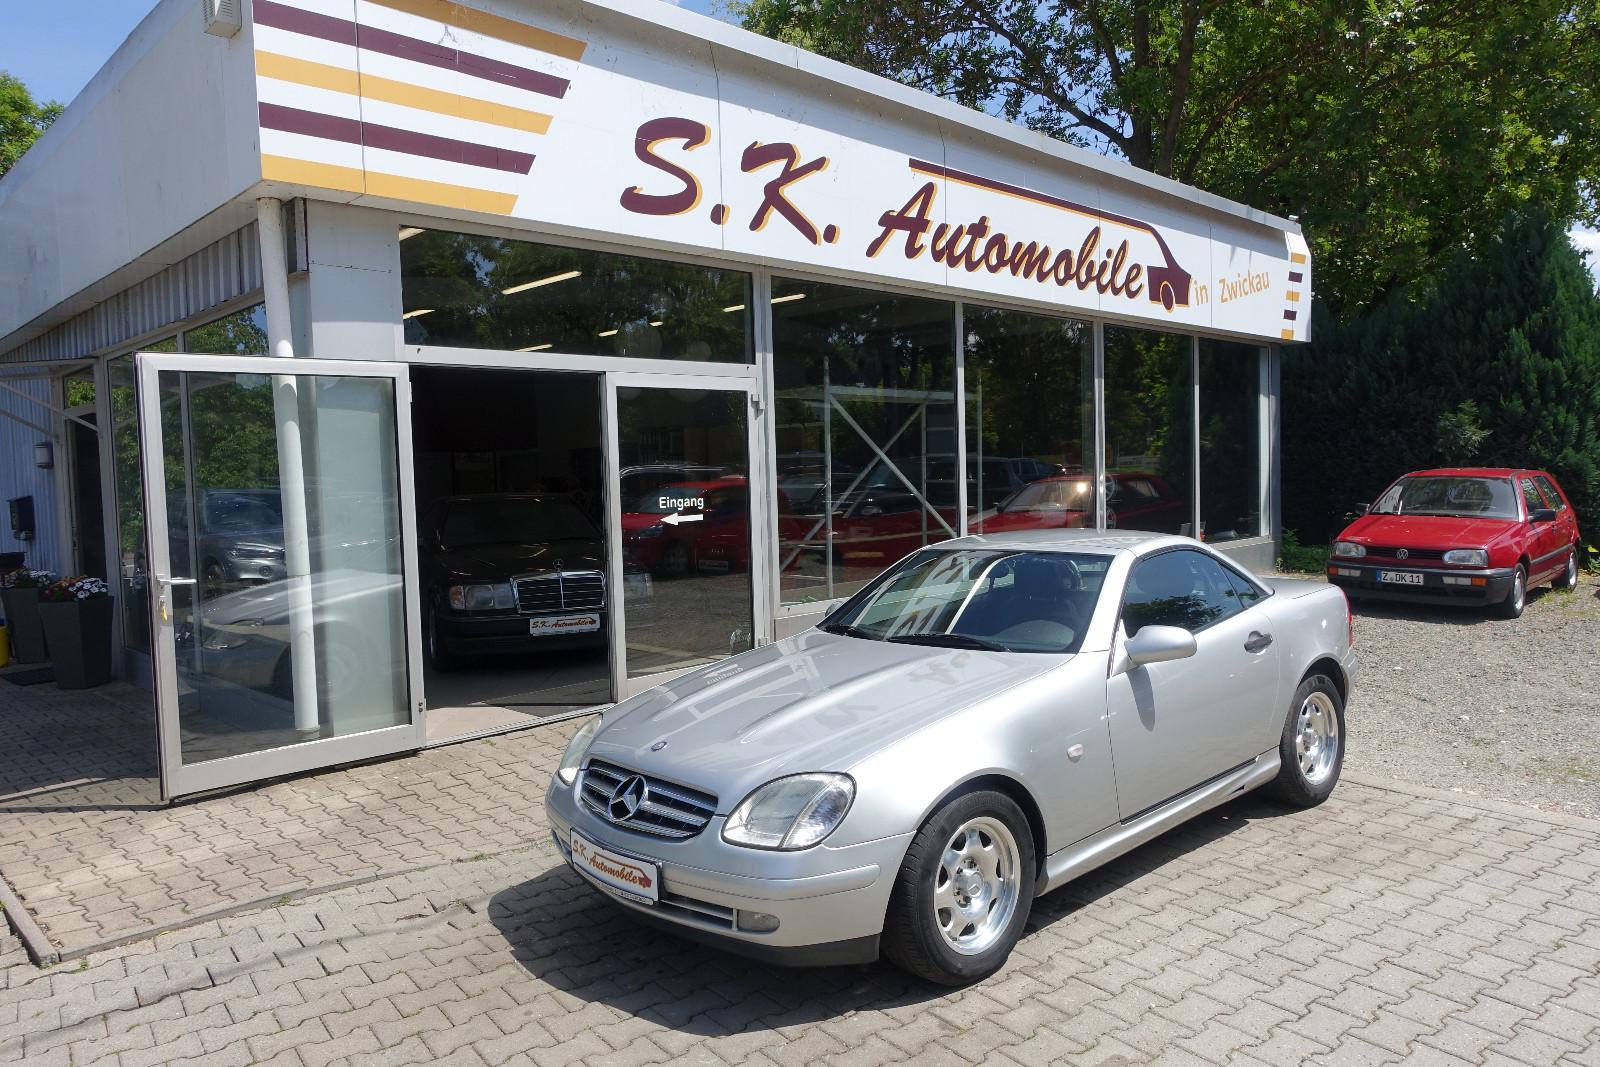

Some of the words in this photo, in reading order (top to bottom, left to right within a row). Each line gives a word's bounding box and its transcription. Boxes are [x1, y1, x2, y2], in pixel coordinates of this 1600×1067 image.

[866, 181, 1145, 298] Automobile
[1195, 279, 1209, 306] in
[1218, 269, 1270, 304] Zwickau
[658, 496, 704, 511] Eingang
[1382, 572, 1388, 581] Z
[1409, 574, 1421, 584] 11
[589, 854, 640, 884] Automobile
